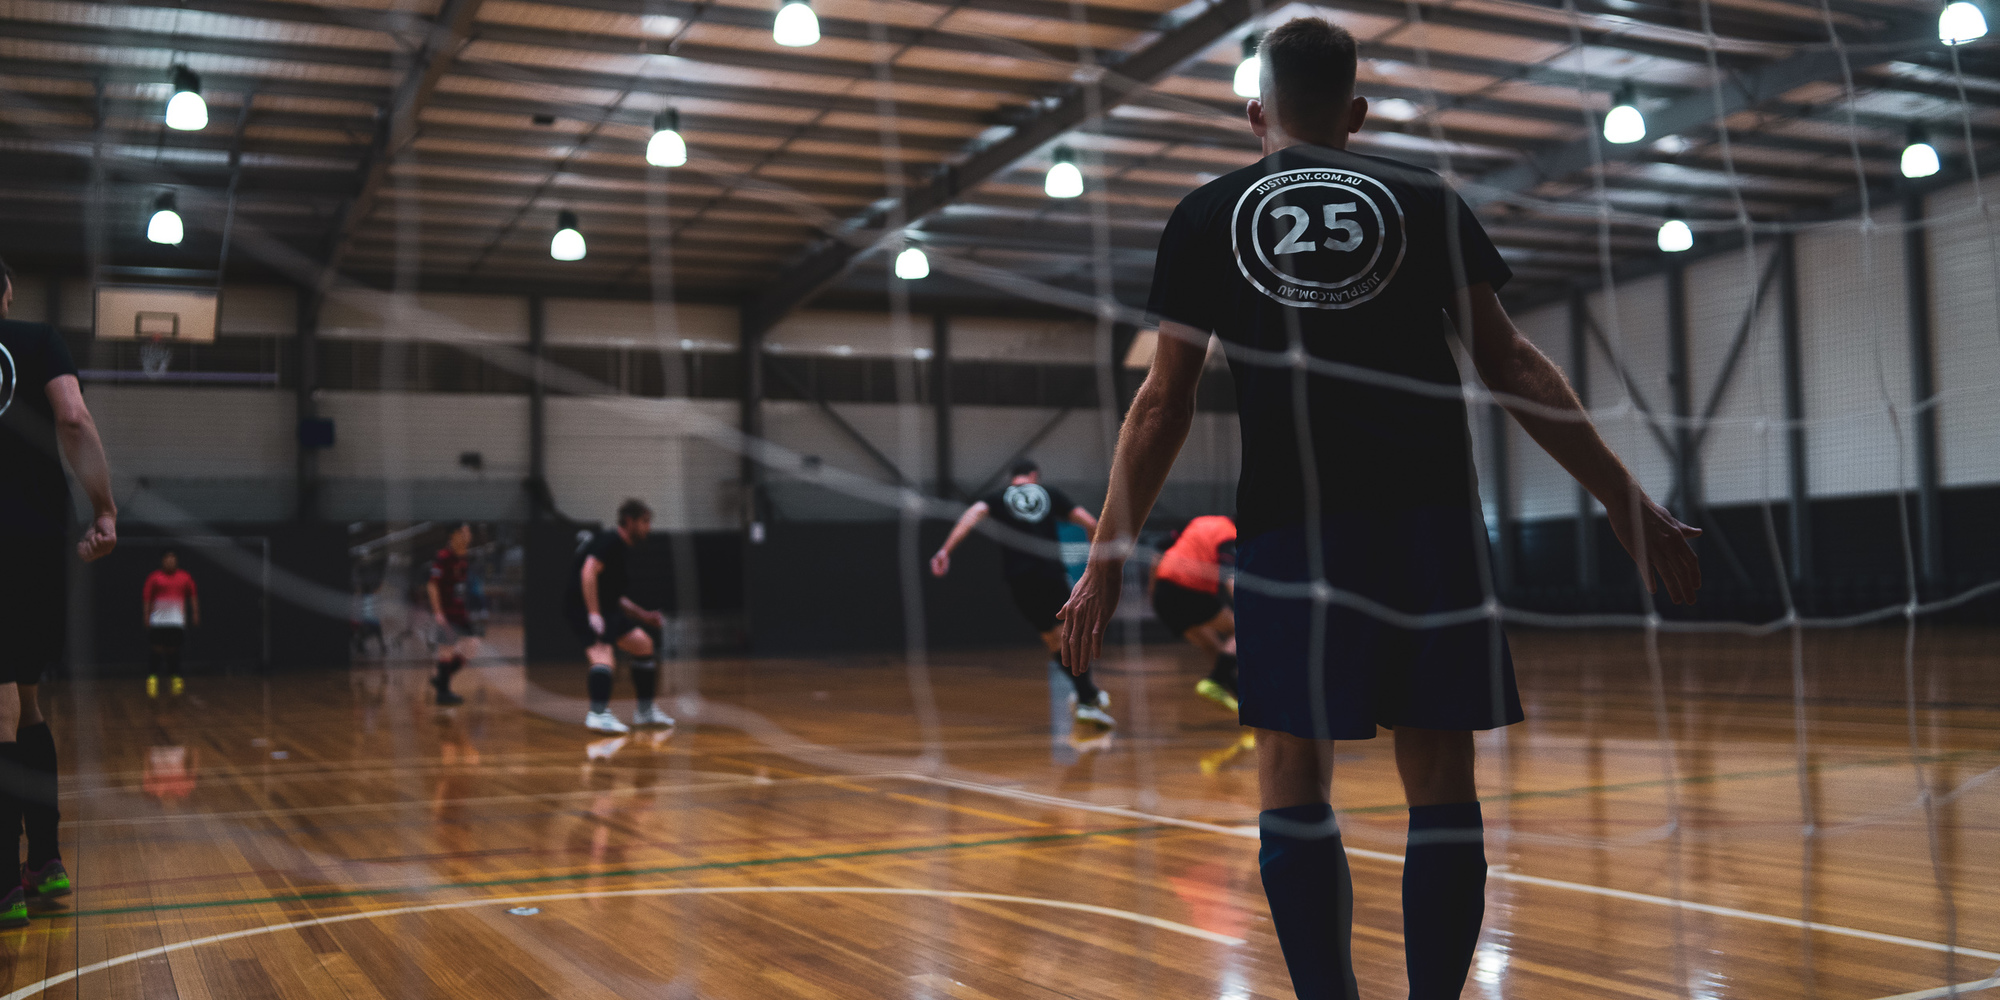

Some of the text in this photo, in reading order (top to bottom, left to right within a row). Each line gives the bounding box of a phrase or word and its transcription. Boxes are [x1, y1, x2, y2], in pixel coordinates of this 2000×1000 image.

[1256, 172, 1362, 195] JUSTPLAY.COM.AU
[1269, 201, 1364, 255] 25
[1277, 272, 1380, 302] JUSTPLAY.COM.AU
